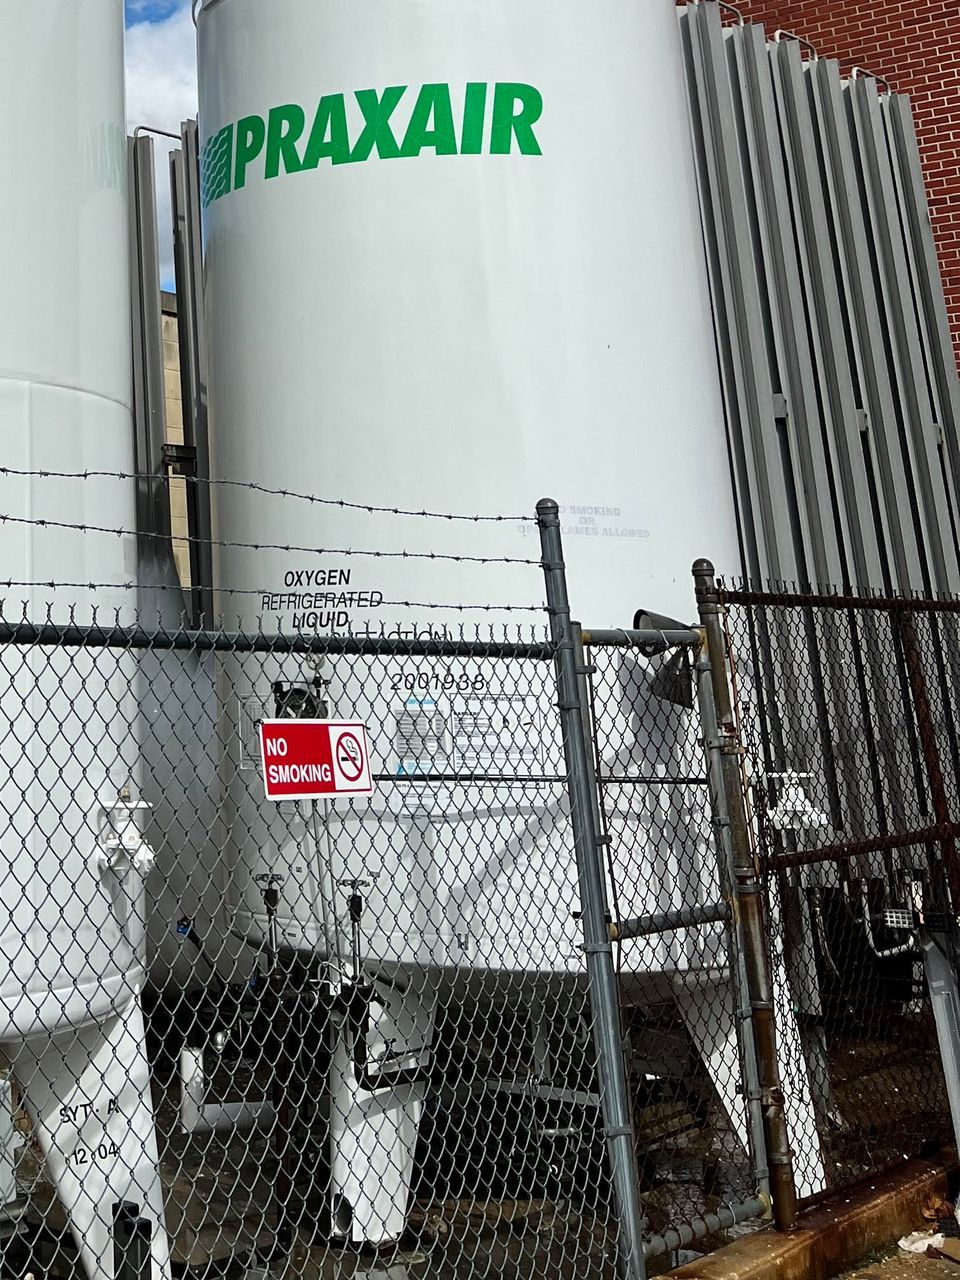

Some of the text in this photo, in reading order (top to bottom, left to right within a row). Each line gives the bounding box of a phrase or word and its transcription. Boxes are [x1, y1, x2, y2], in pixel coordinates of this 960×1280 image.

[234, 82, 544, 190] PRAXAIR
[284, 569, 351, 587] OXYGEN
[261, 591, 383, 610] REFRIGERATED
[292, 611, 349, 629] LIQUID
[390, 673, 485, 691] 2001938
[266, 738, 288, 756] NO
[268, 764, 332, 784] SMOKING
